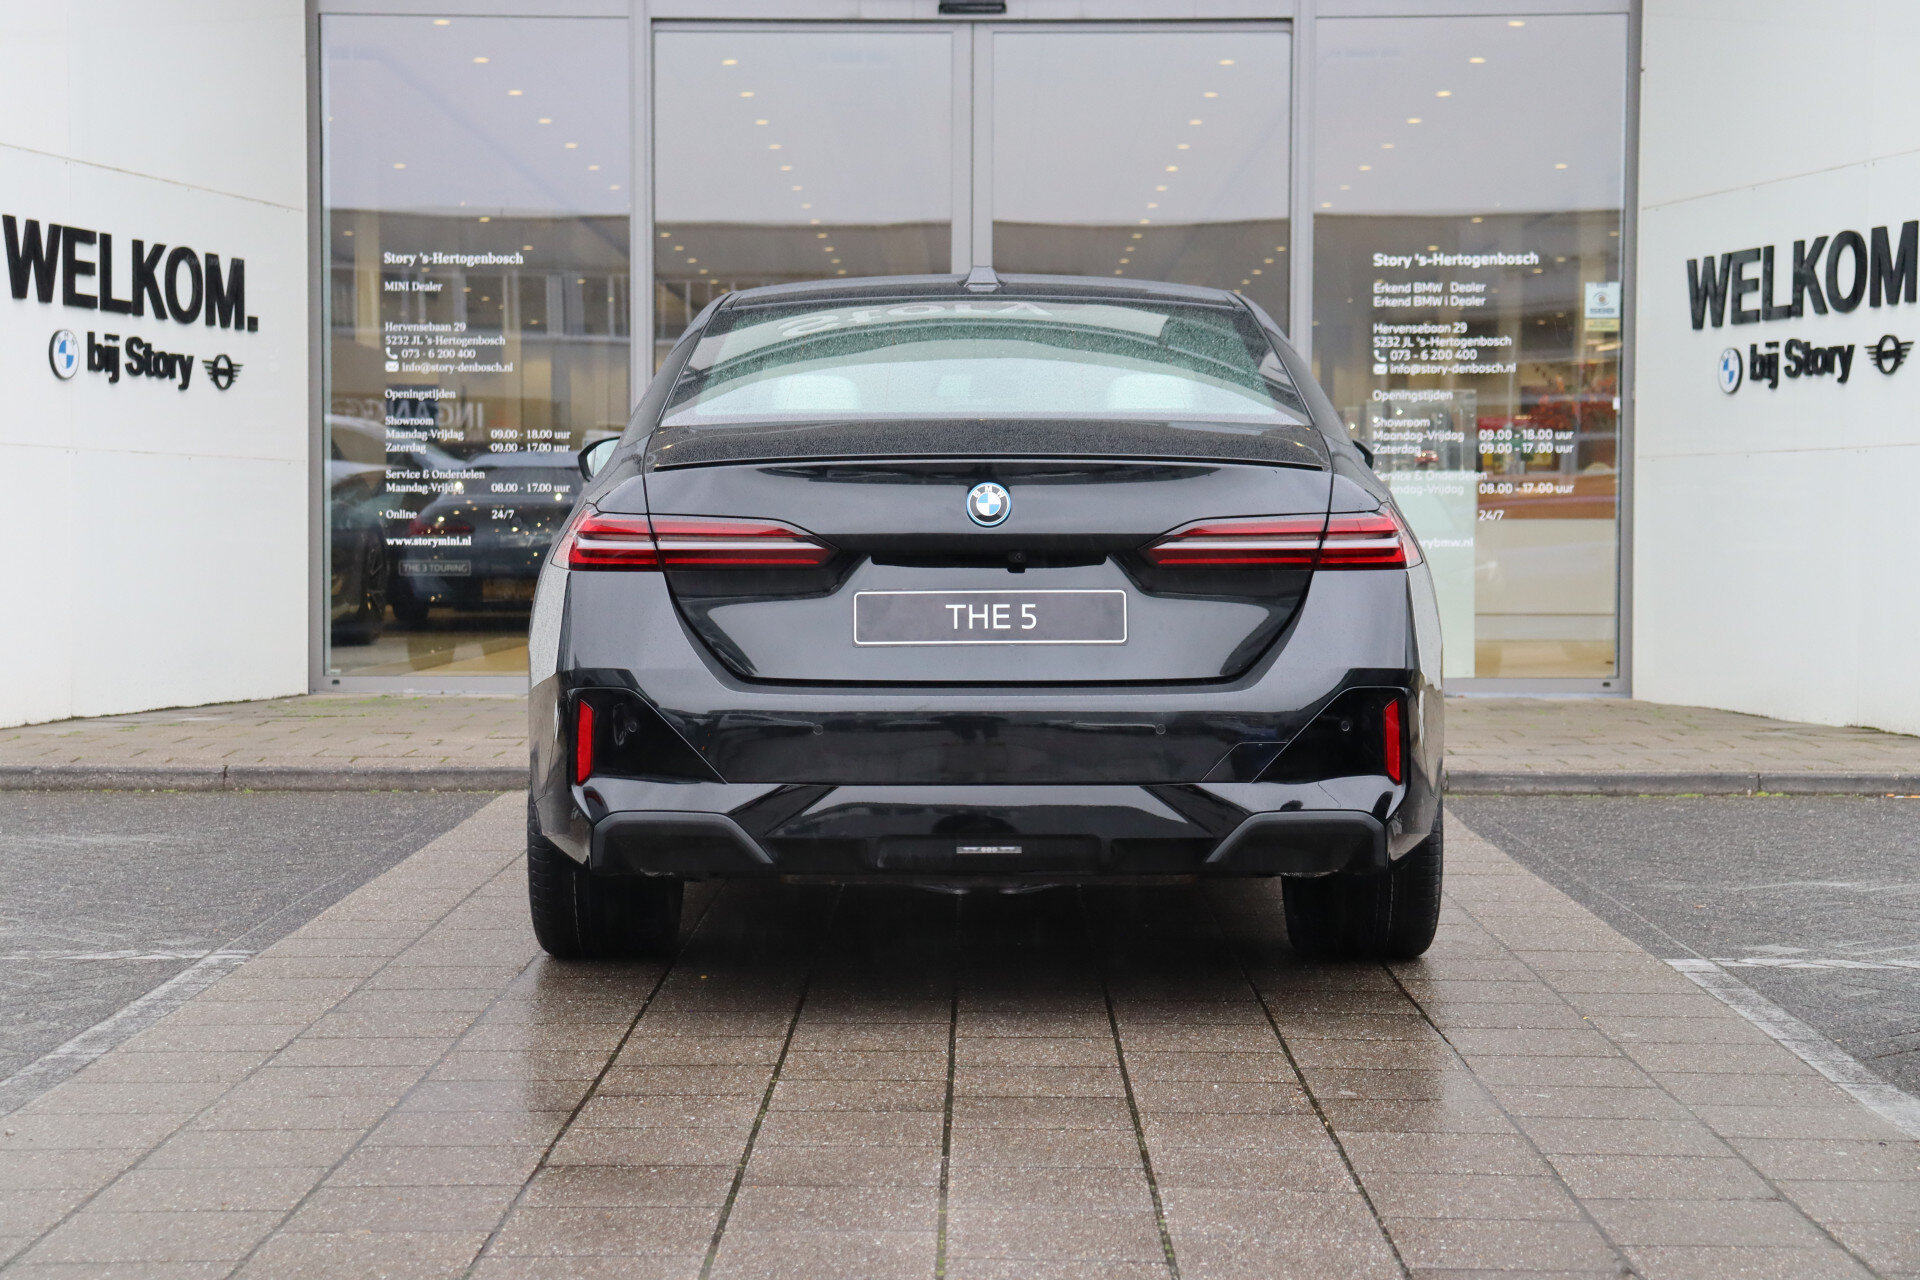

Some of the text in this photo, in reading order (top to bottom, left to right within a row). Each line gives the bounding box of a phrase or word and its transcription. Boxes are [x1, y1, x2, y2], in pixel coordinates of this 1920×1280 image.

[384, 252, 524, 267] Story 's-Hertogenbosch
[1373, 252, 1539, 268] Story 's-Hertogenbosch
[2, 214, 258, 332] WELKOM.
[384, 281, 443, 292] MINI Dealer
[1373, 281, 1486, 294] Erkend BMW Dealer
[1373, 296, 1411, 307] Erkend
[1413, 296, 1443, 307] BMW
[1450, 296, 1486, 307] Dealer
[385, 322, 466, 332] Hervensebaan 29
[1373, 322, 1468, 334] Hervensebaan 29
[385, 335, 506, 347] 5232 JL 's-Hertogenbosch
[1373, 335, 1512, 349] 5232 JL 's-Hertogenbosch
[401, 349, 420, 359] 073
[428, 349, 435, 359] 6
[437, 349, 455, 359] 200
[457, 349, 476, 359] 400
[1390, 350, 1411, 361] 073
[1420, 350, 1429, 361] 6
[1430, 350, 1453, 361] 200
[1455, 350, 1478, 361] 400
[87, 331, 194, 391] bij Story
[1750, 338, 1855, 390] bij Story
[402, 361, 514, 374] info@story-denbosch.nl
[1390, 363, 1517, 376] info@story-denbosch.nl
[385, 389, 456, 401] Openingstijden
[1372, 389, 1453, 402] Openingstijden
[385, 416, 434, 426] Showroom
[1373, 417, 1431, 428] Showroom
[385, 429, 464, 441] Maandag-Vrijdag
[490, 429, 518, 439] 09.00
[526, 429, 552, 439] 18.00
[1373, 430, 1464, 443] Maandag-Vrijdag
[1479, 429, 1512, 440] 09.00
[1522, 429, 1553, 440] 18.00
[1555, 432, 1574, 440] uur
[385, 443, 427, 454] Zaterdag
[490, 443, 518, 453] 09.00
[527, 443, 552, 453] 17.00
[553, 445, 571, 453] uur
[1373, 443, 1422, 455] Zaterdag
[1479, 443, 1512, 454] 09.00
[1555, 445, 1574, 454] uur
[385, 470, 420, 479] Service
[431, 470, 485, 479] Onderdelen
[1425, 471, 1488, 481] Onderdelen
[491, 483, 518, 493] 08.00
[527, 483, 552, 493] 17.00
[554, 485, 571, 493] uur
[1390, 484, 1464, 496] andag-Vrijdag
[1479, 483, 1513, 494] 08.00
[1555, 485, 1574, 494] uur
[386, 509, 514, 520] Online 24/7
[1479, 510, 1504, 521] 24/7
[386, 536, 472, 547] www.storymini.nl
[430, 563, 468, 573] TOURING
[945, 604, 1037, 630] THE 5
